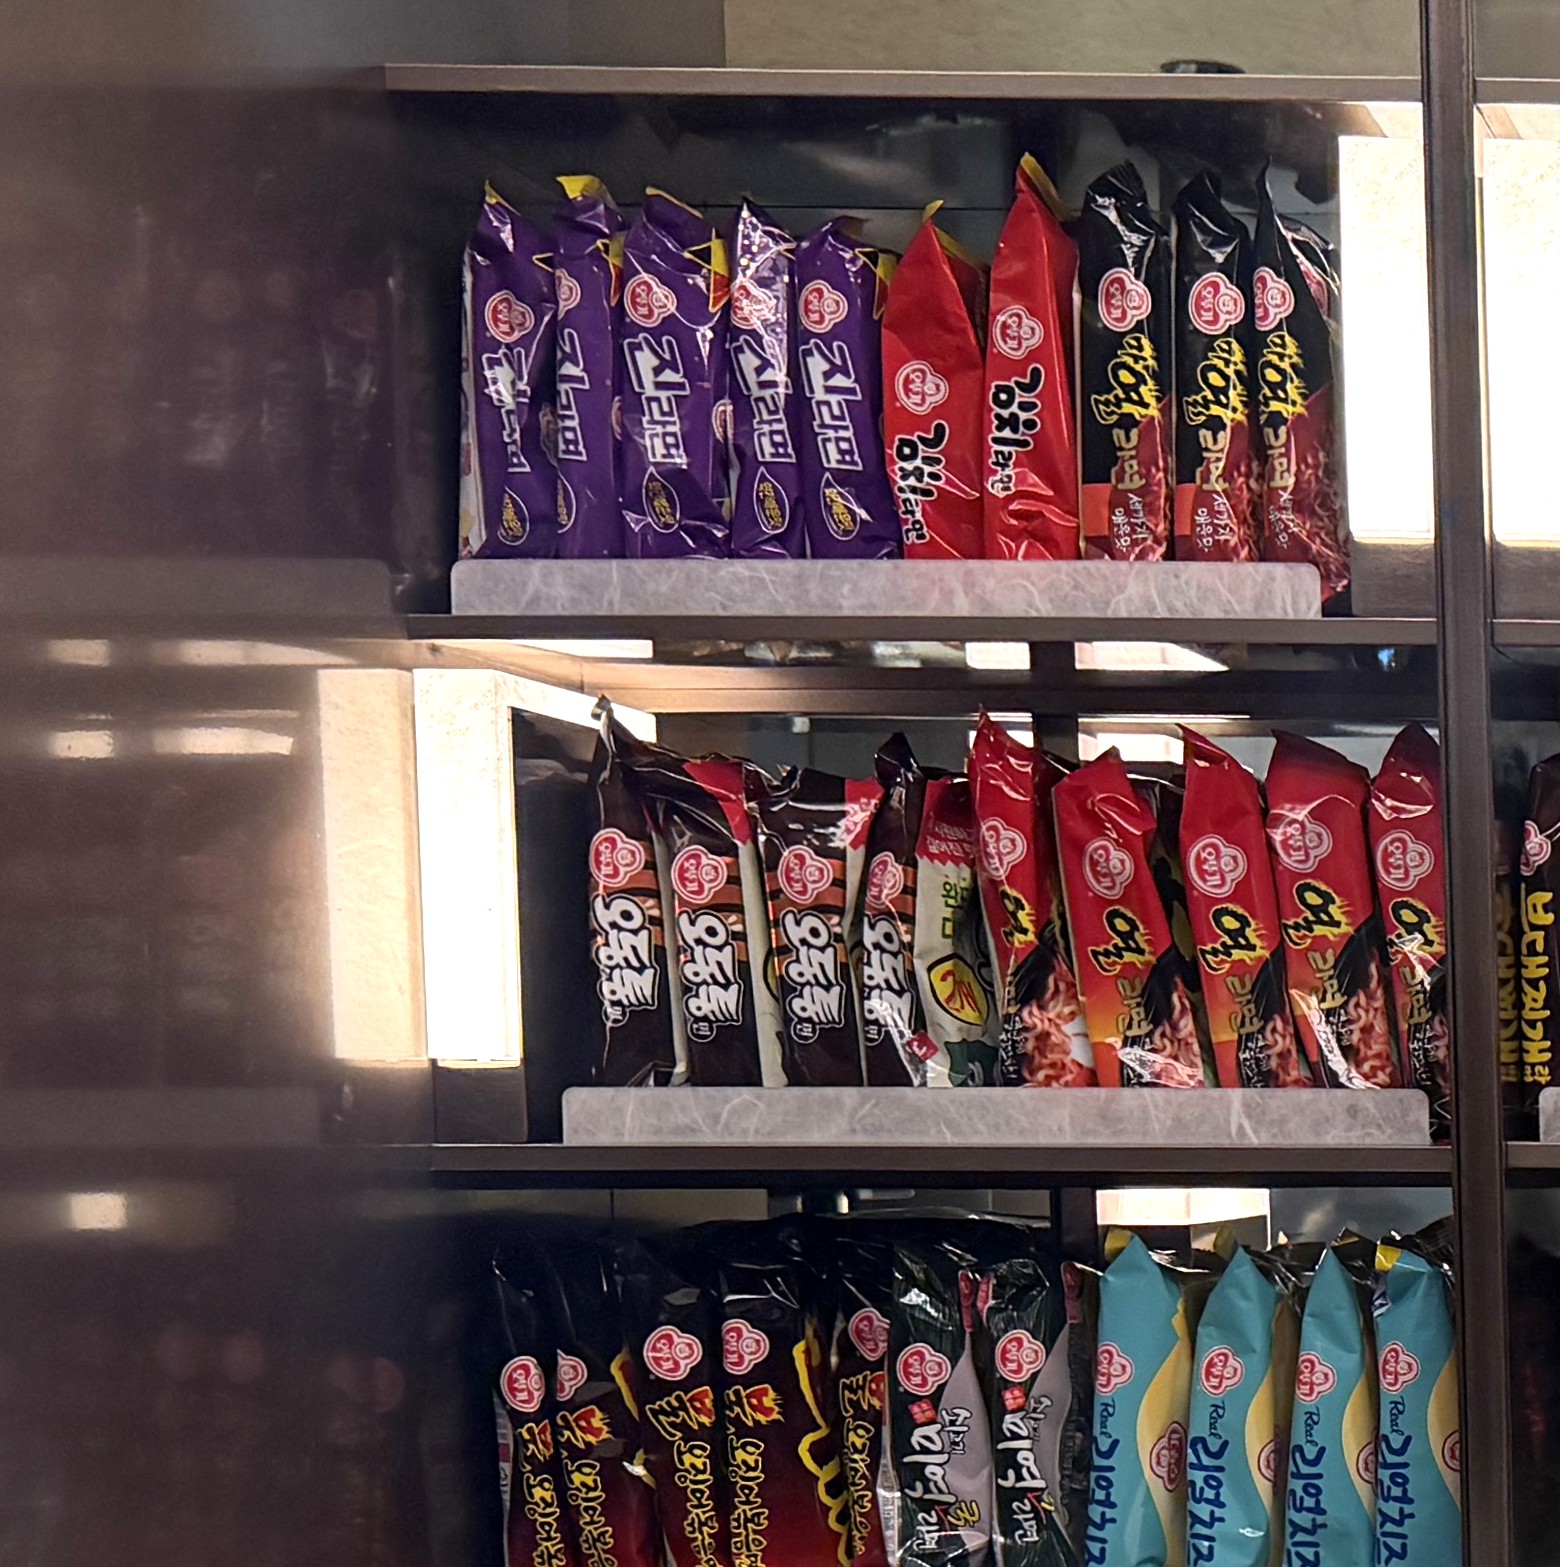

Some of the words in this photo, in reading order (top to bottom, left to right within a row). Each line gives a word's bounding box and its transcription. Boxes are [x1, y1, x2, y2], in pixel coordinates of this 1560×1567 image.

[624, 333, 690, 468] 진라면
[730, 336, 796, 464] 진라면
[799, 339, 863, 471] 진라면
[988, 364, 1044, 496] 김치라면
[894, 421, 947, 543] 김치라면
[678, 909, 744, 1043] 오동통면
[780, 907, 845, 1044] 오동통면
[1012, 1498, 1040, 1546] 라면
[1186, 1437, 1229, 1564] 리얼치즈
